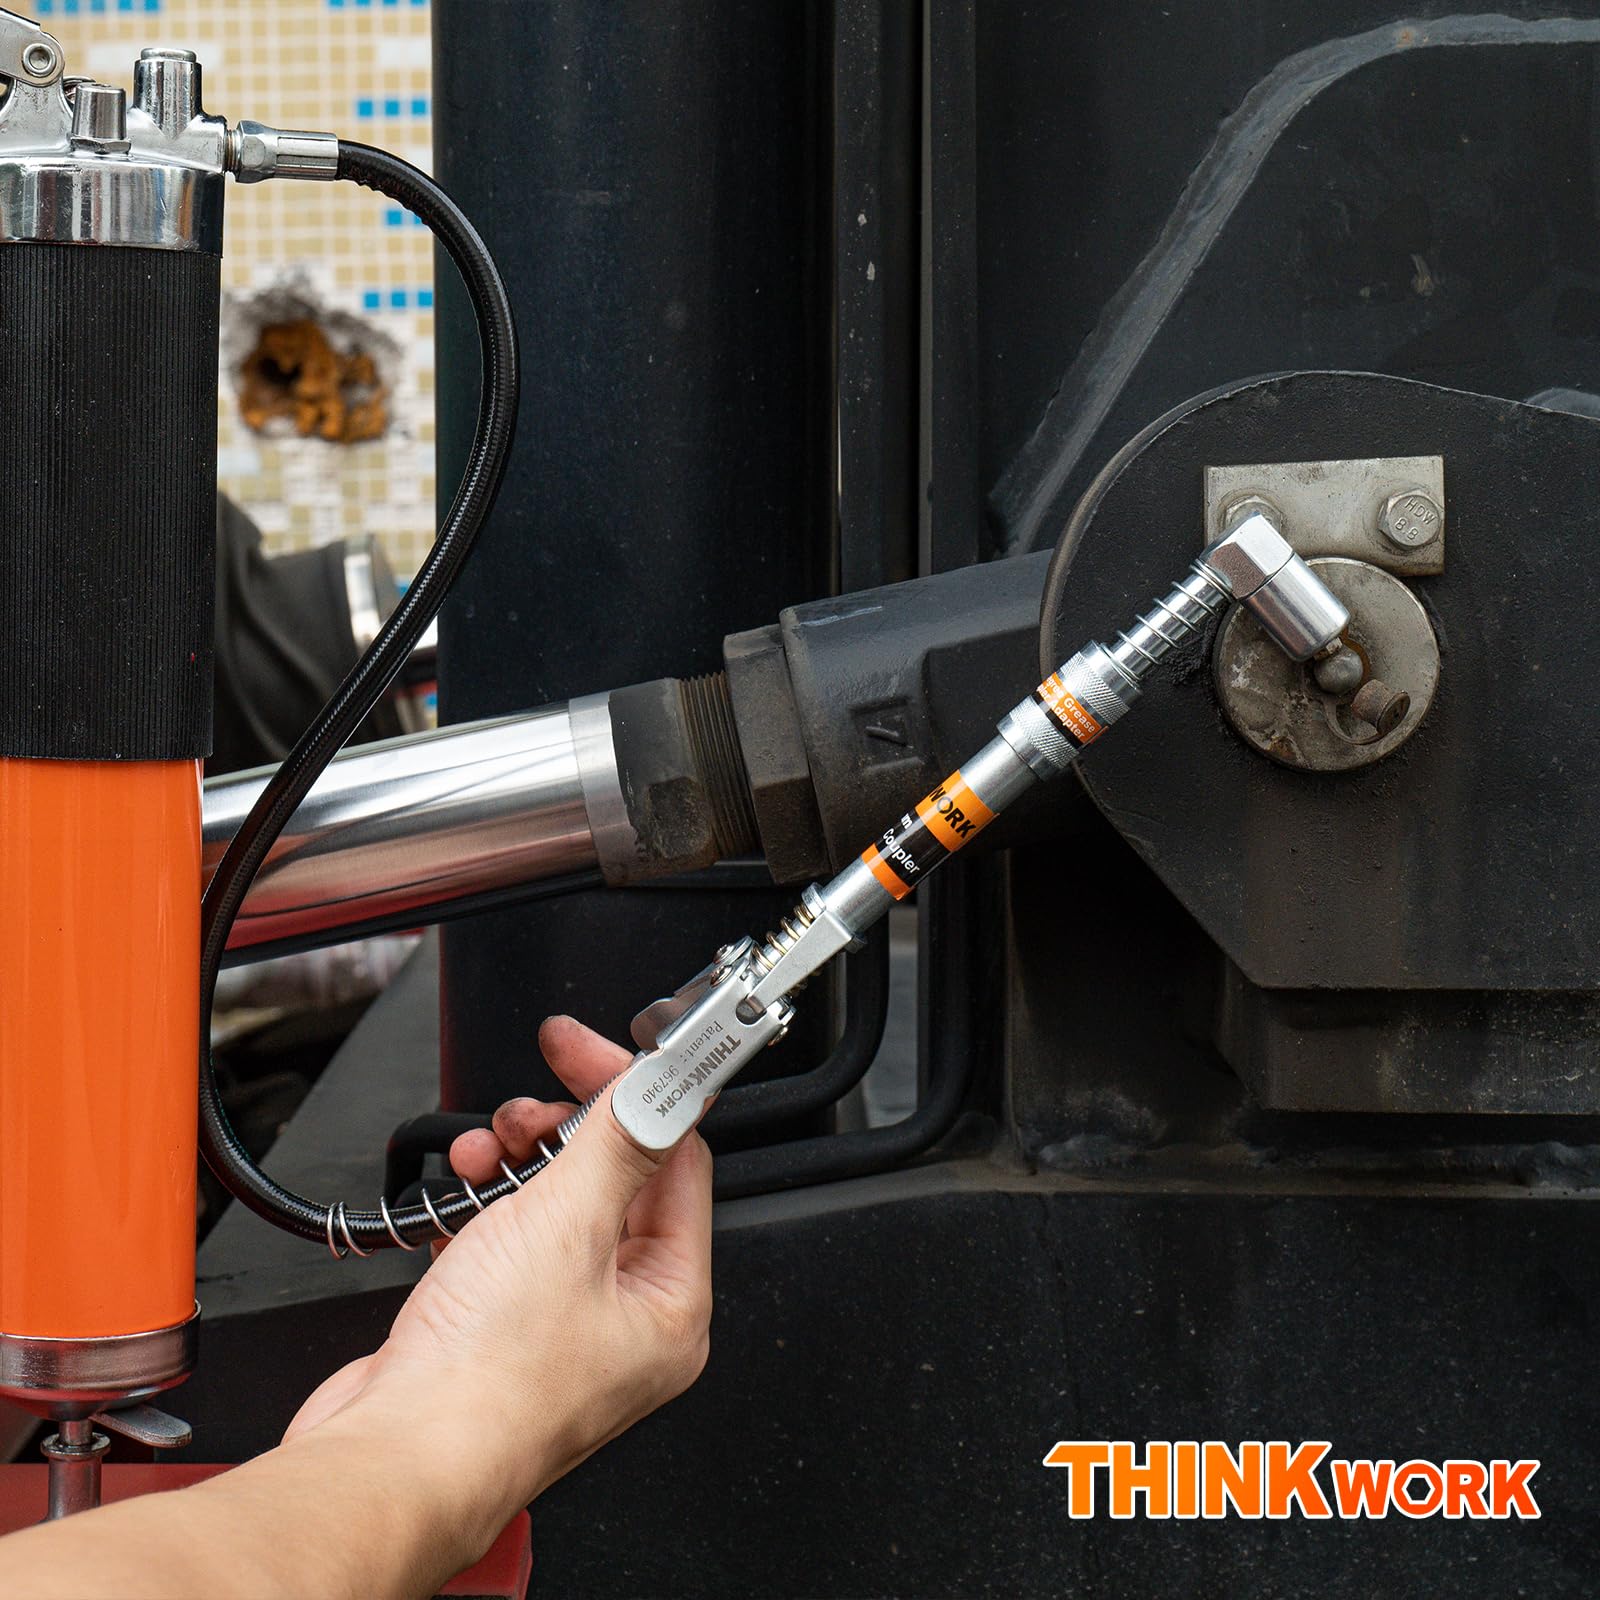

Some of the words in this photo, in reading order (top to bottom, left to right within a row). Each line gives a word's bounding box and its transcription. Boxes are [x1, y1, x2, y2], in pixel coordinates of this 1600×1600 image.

[1404, 496, 1437, 525] HDW
[1049, 698, 1085, 739] Adapter
[1063, 697, 1096, 733] Grease
[882, 828, 920, 874] Coupler
[641, 1064, 680, 1105] 967940
[655, 1034, 742, 1119] THINKWORK
